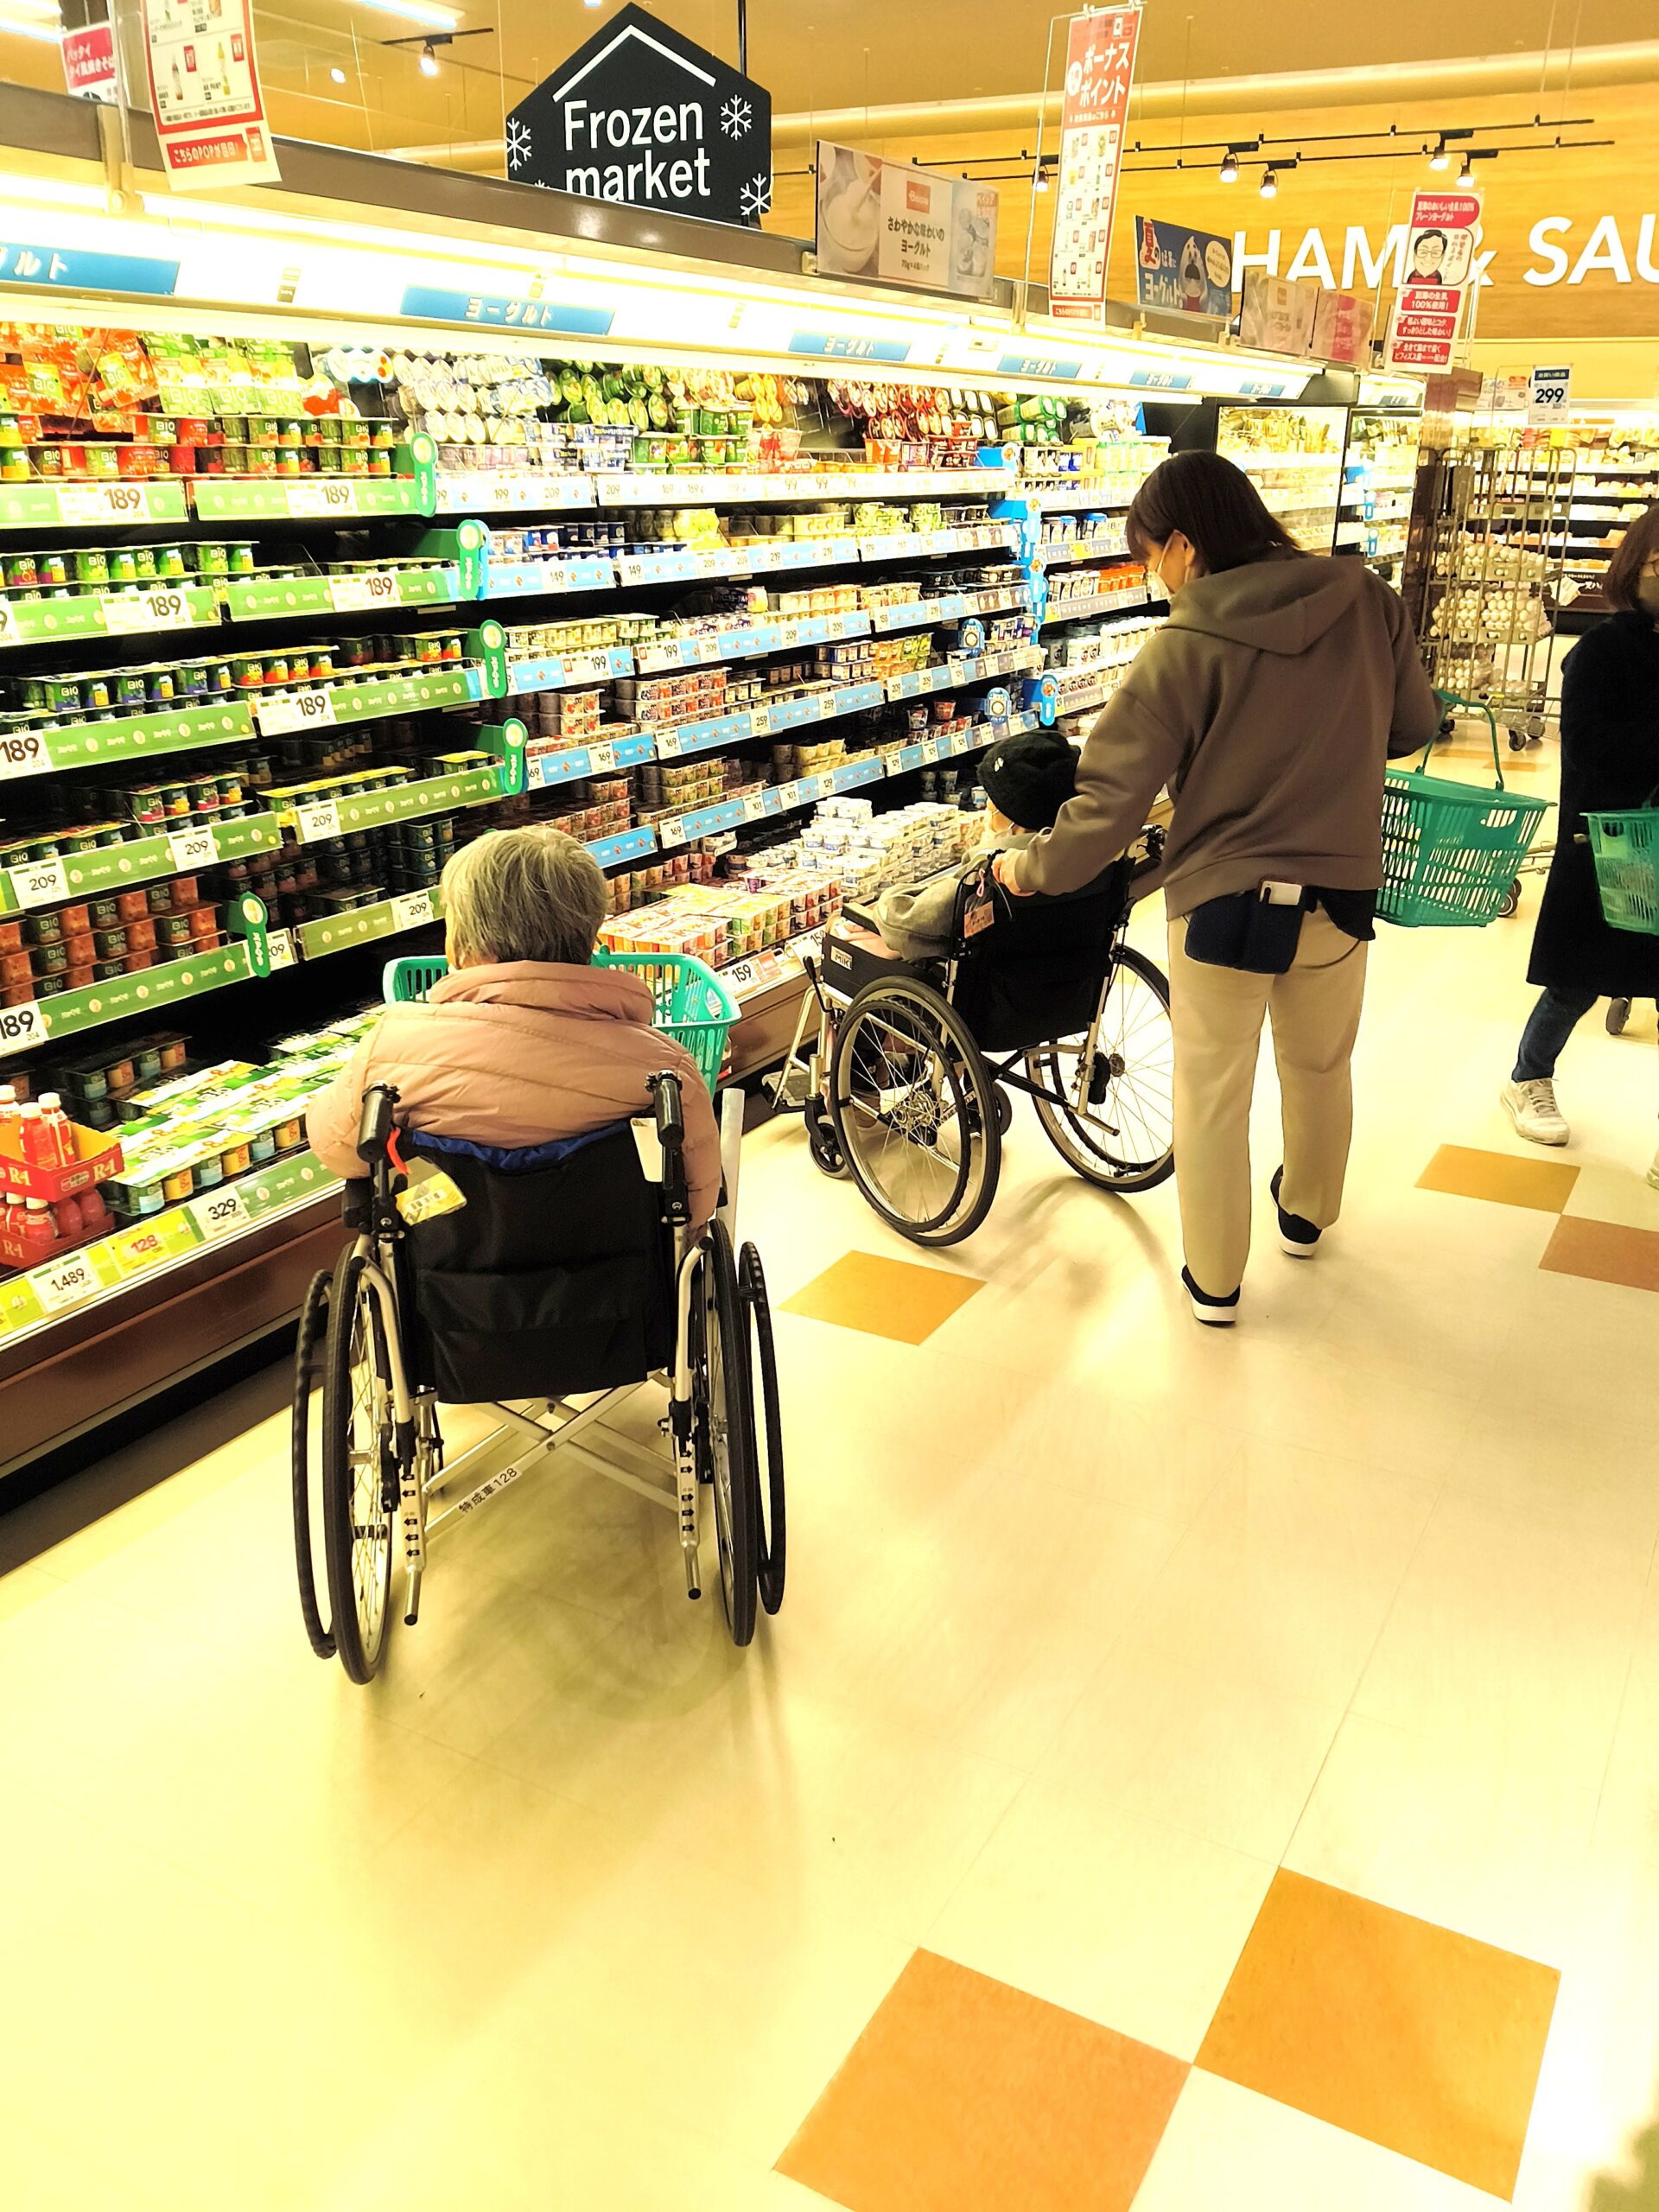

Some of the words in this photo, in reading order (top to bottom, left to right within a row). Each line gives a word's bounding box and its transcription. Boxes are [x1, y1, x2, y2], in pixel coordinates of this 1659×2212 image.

[1084, 42, 1130, 75] ボーナス
[1079, 75, 1126, 108] ポイント
[564, 100, 703, 151] Frozen
[566, 148, 711, 201] market
[887, 216, 945, 242] さわやかな味わいの
[901, 239, 931, 257] ヨーグルト
[1231, 224, 1410, 293] HAM
[465, 297, 554, 327] ヨーグルト
[823, 336, 874, 357] ヨーグルト
[1535, 388, 1565, 404] 299
[321, 486, 349, 504] 189
[494, 488, 509, 500] 199
[544, 487, 560, 499] 209
[606, 484, 620, 496] 209
[104, 488, 141, 510] 189
[550, 570, 564, 582] 149
[628, 564, 641, 575] 149
[365, 576, 392, 596] 189
[146, 595, 181, 617] 189
[785, 629, 797, 640] 209
[832, 622, 842, 632] 209
[664, 644, 677, 658] 199
[705, 643, 717, 652] 209
[591, 655, 606, 671] 199
[296, 695, 326, 717] 189
[823, 698, 835, 709] 259
[756, 715, 767, 727] 259
[0, 737, 39, 763] 189
[665, 737, 677, 747] 169
[599, 751, 611, 762] 169
[528, 767, 540, 778] 69
[823, 778, 833, 788] 129
[787, 790, 797, 799] 101
[753, 801, 762, 810] 101
[312, 813, 333, 828] 209
[670, 825, 682, 836] 169
[185, 840, 208, 855] 209
[29, 874, 57, 892] 209
[409, 903, 427, 916] 209
[269, 944, 285, 957] 09
[732, 963, 752, 983] 159
[0, 1010, 34, 1040] 189
[9, 1166, 32, 1186] R-1
[93, 1158, 118, 1182] R-1
[208, 1198, 238, 1220] 329
[4, 1240, 25, 1259] R-1
[130, 1234, 158, 1254] 128
